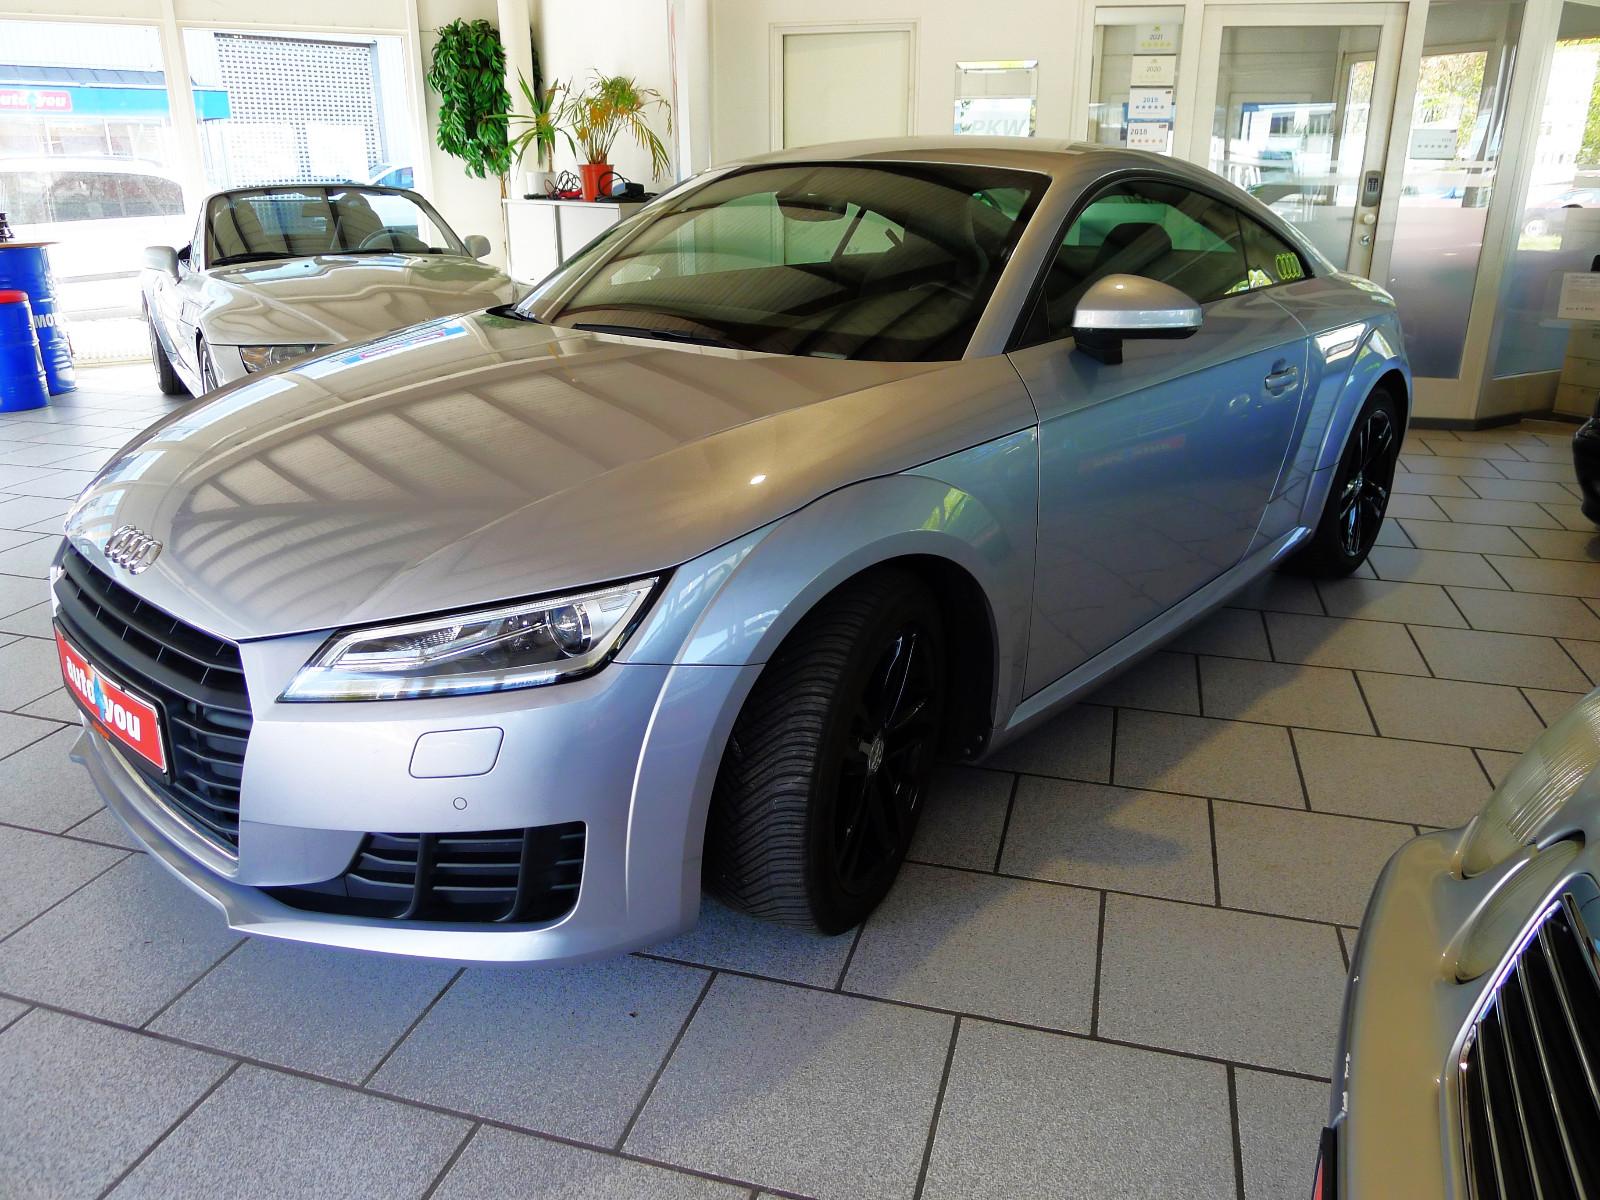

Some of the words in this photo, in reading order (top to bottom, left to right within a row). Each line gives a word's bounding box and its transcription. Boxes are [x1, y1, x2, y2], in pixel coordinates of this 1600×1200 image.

[0, 94, 27, 106] uto
[35, 95, 67, 108] you
[971, 119, 1027, 136] PKW
[66, 655, 97, 705] auto
[102, 695, 141, 742] you
